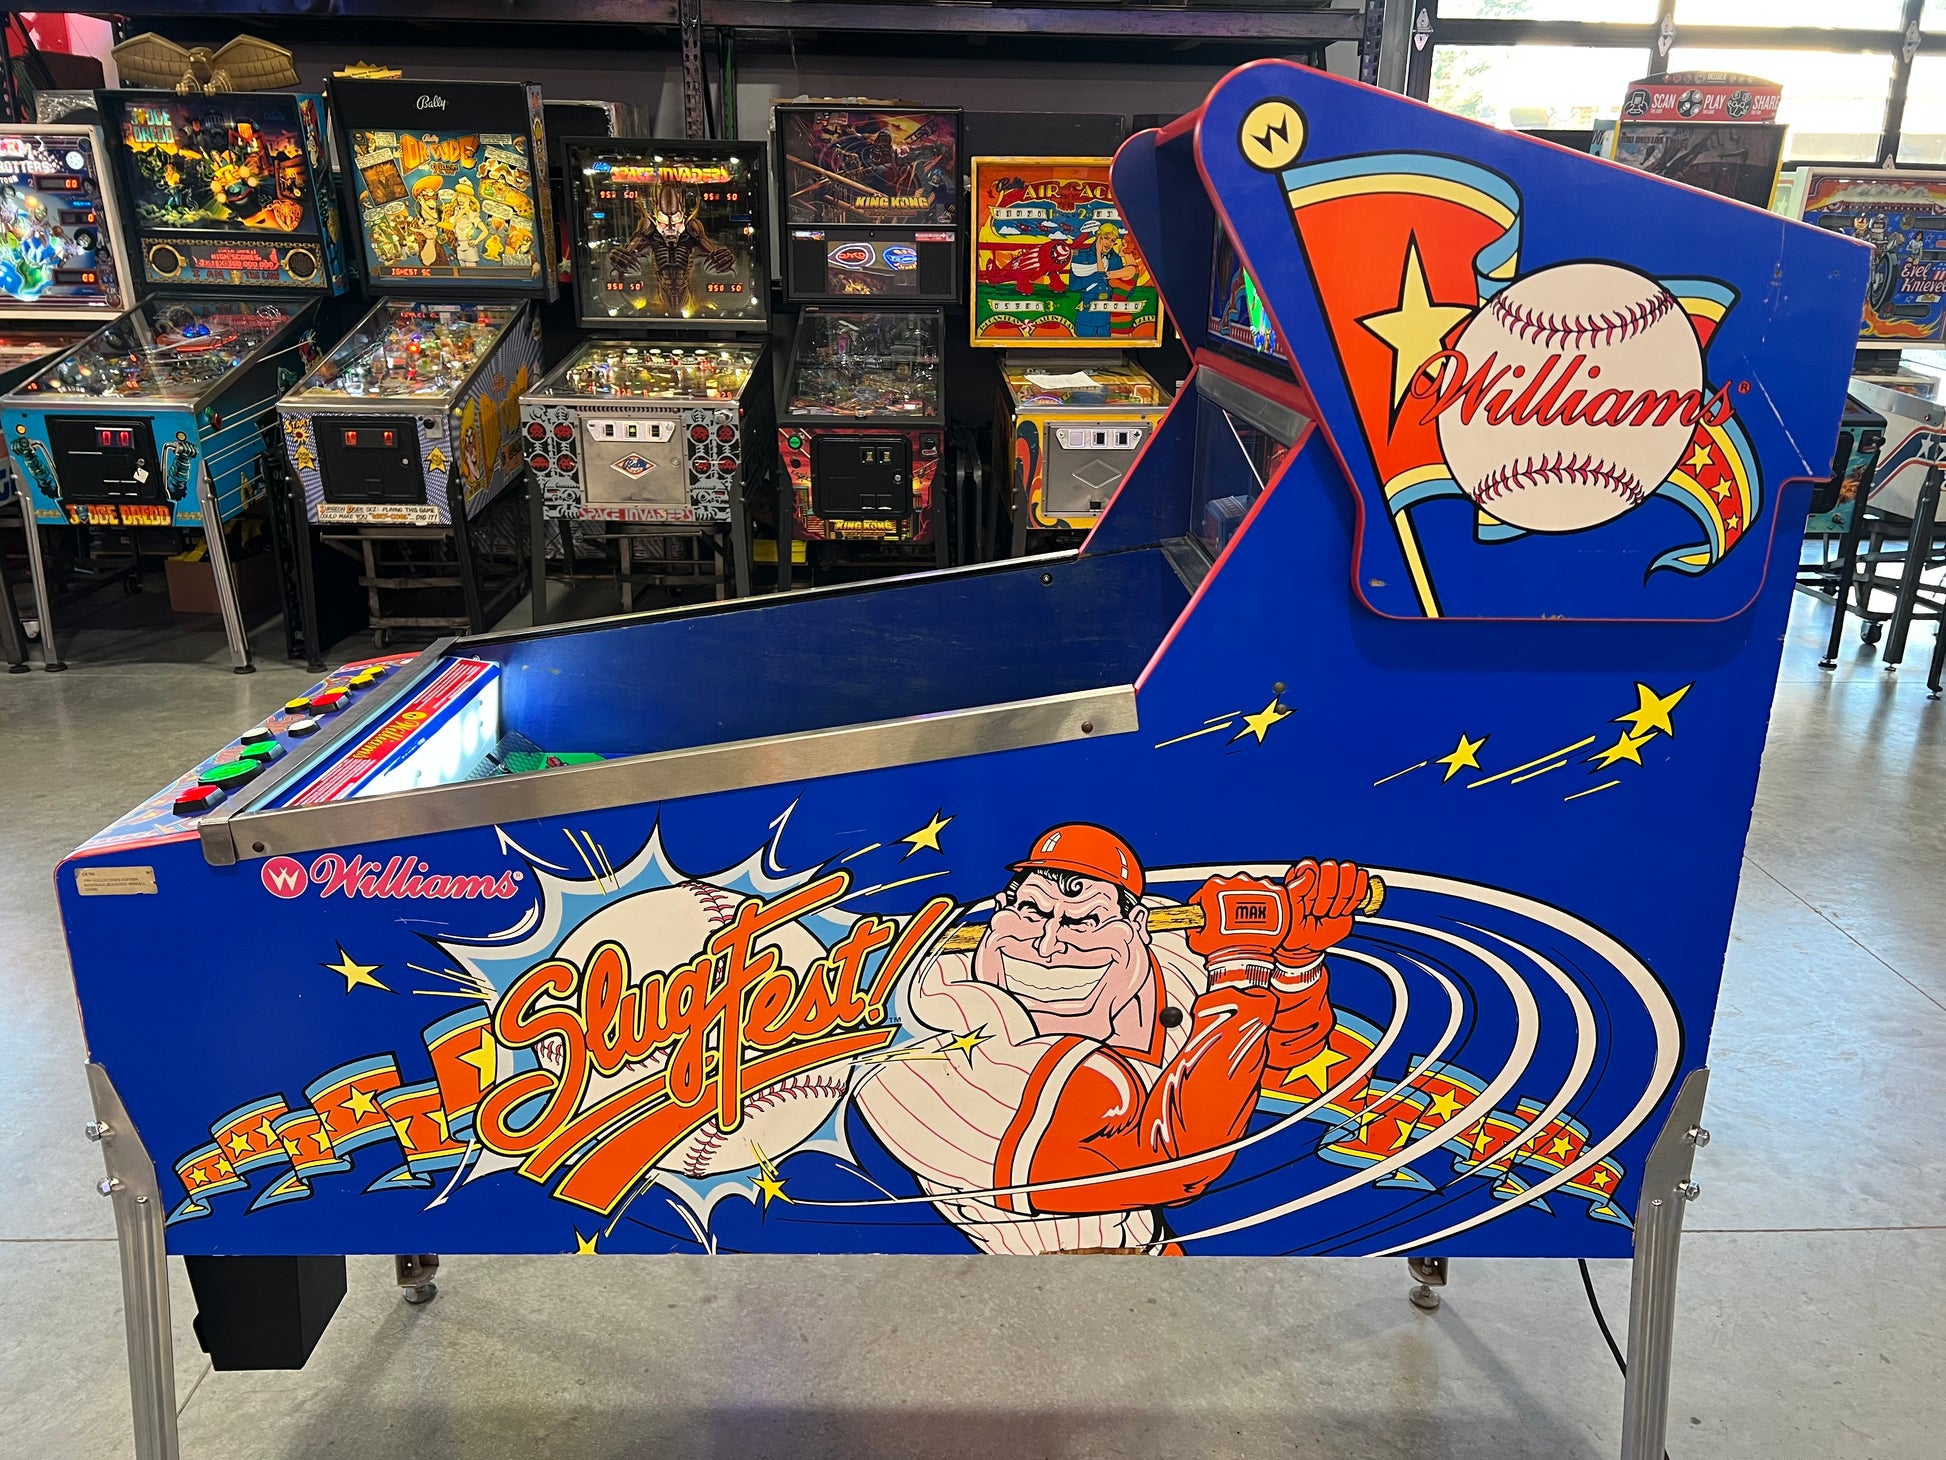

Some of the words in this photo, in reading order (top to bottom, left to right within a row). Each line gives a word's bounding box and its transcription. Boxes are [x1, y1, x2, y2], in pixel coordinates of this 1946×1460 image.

[416, 94, 448, 110] Bally
[1652, 94, 1677, 109] SCAN
[1703, 94, 1727, 110] PLAY
[612, 166, 655, 182] SPACE
[658, 166, 731, 183] INVADERS
[1022, 184, 1061, 199] AIR
[1079, 184, 1112, 199] AC
[854, 195, 890, 209] KING
[890, 195, 931, 209] KONG
[1412, 349, 1739, 427] Williams
[119, 504, 172, 526] DREDD
[579, 507, 620, 521] SPACE
[624, 507, 695, 521] INVADERS
[836, 520, 863, 531] KING
[863, 520, 894, 531] KONG
[309, 852, 519, 899] Williams
